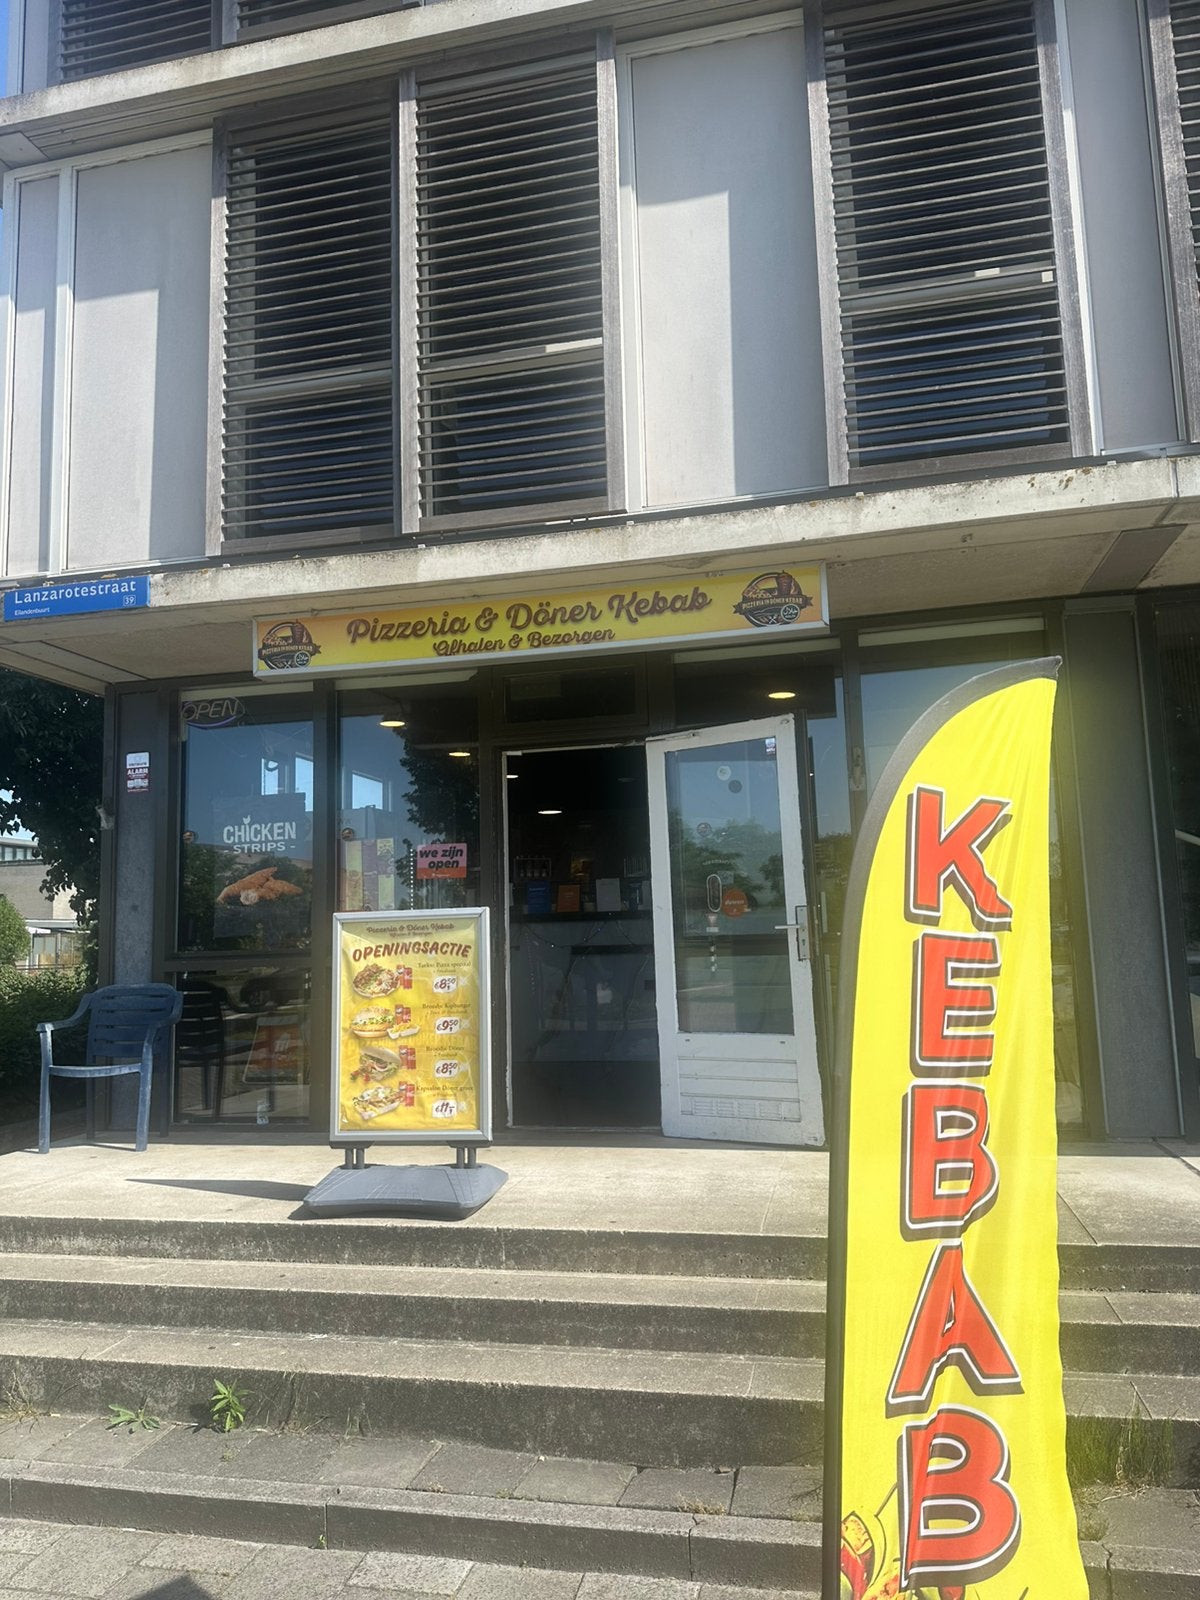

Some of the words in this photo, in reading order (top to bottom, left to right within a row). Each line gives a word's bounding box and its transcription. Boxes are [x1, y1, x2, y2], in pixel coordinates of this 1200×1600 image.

[14, 580, 137, 604] Lanzarotestraat
[124, 596, 135, 605] 39
[346, 610, 471, 644] Pizzeria
[474, 606, 499, 632] &
[505, 601, 603, 630] Döner
[607, 586, 713, 623] Kebab
[433, 636, 506, 656] Afhalen
[508, 633, 523, 649] &
[526, 628, 616, 648] Bezorgen
[181, 699, 239, 721] OPEN
[127, 767, 149, 775] ALARM
[223, 818, 297, 844] CHICKEN
[233, 841, 286, 854] STRIPS
[419, 848, 439, 859] we
[441, 846, 464, 860] zijn
[428, 860, 460, 871] open
[352, 940, 472, 962] OPENINGSACTIE
[884, 784, 1026, 1592] KEBAB
